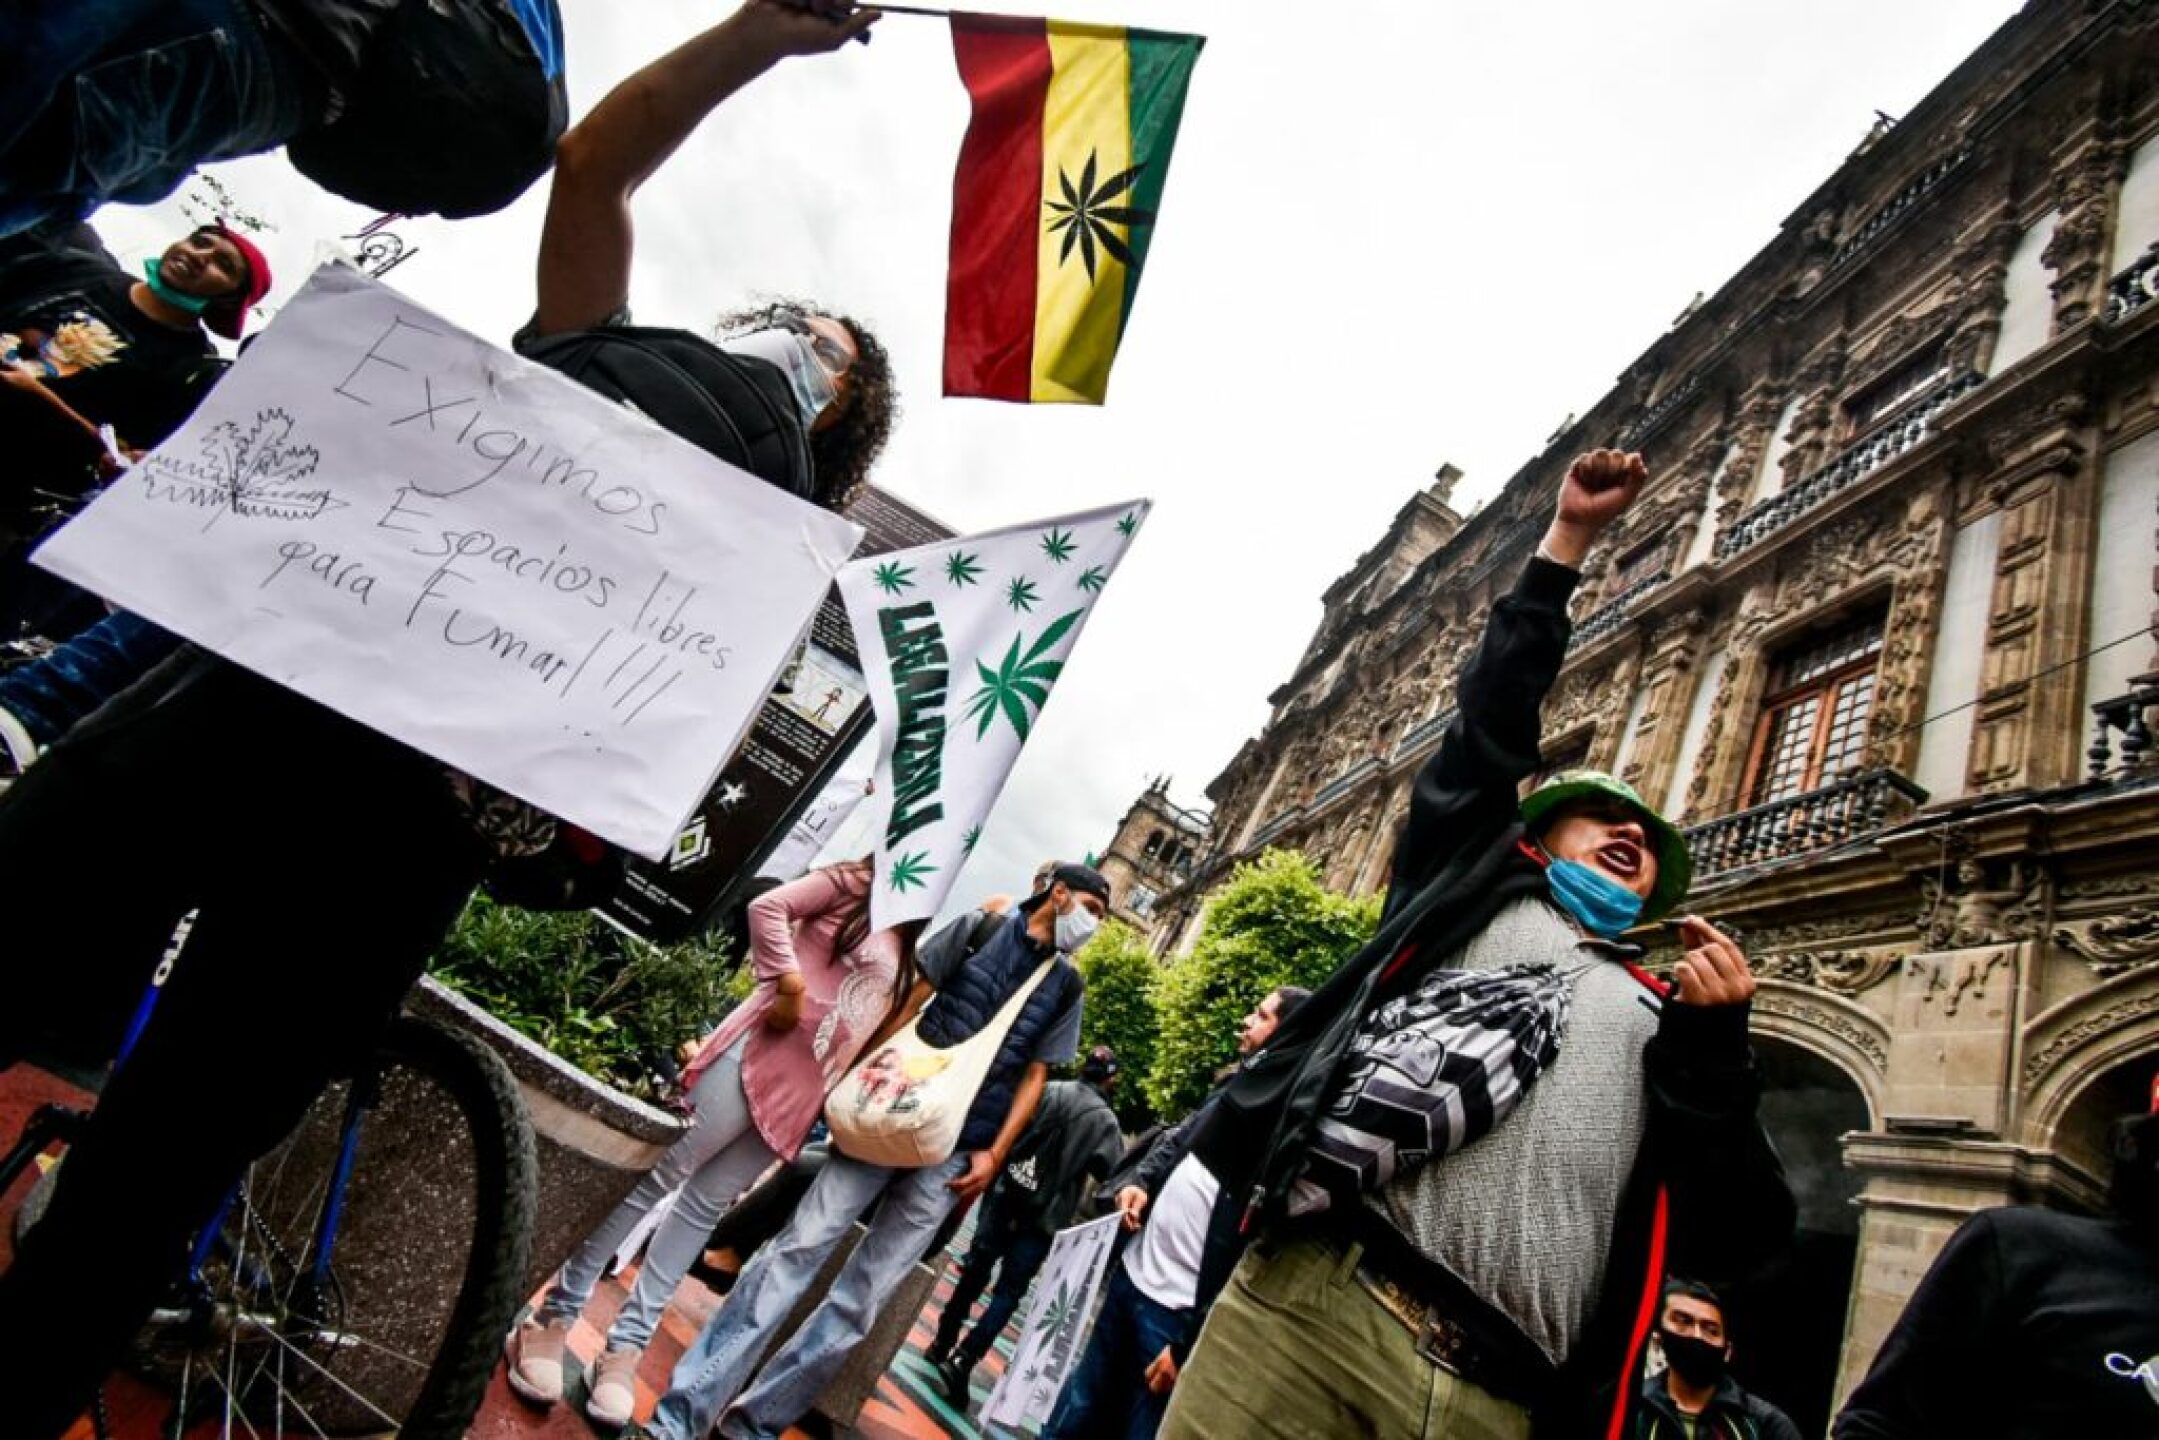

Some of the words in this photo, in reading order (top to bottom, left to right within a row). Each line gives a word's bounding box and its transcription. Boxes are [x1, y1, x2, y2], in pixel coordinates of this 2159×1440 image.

[259, 541, 376, 604] para
[376, 486, 616, 608] Espacios
[632, 570, 732, 669] libres
